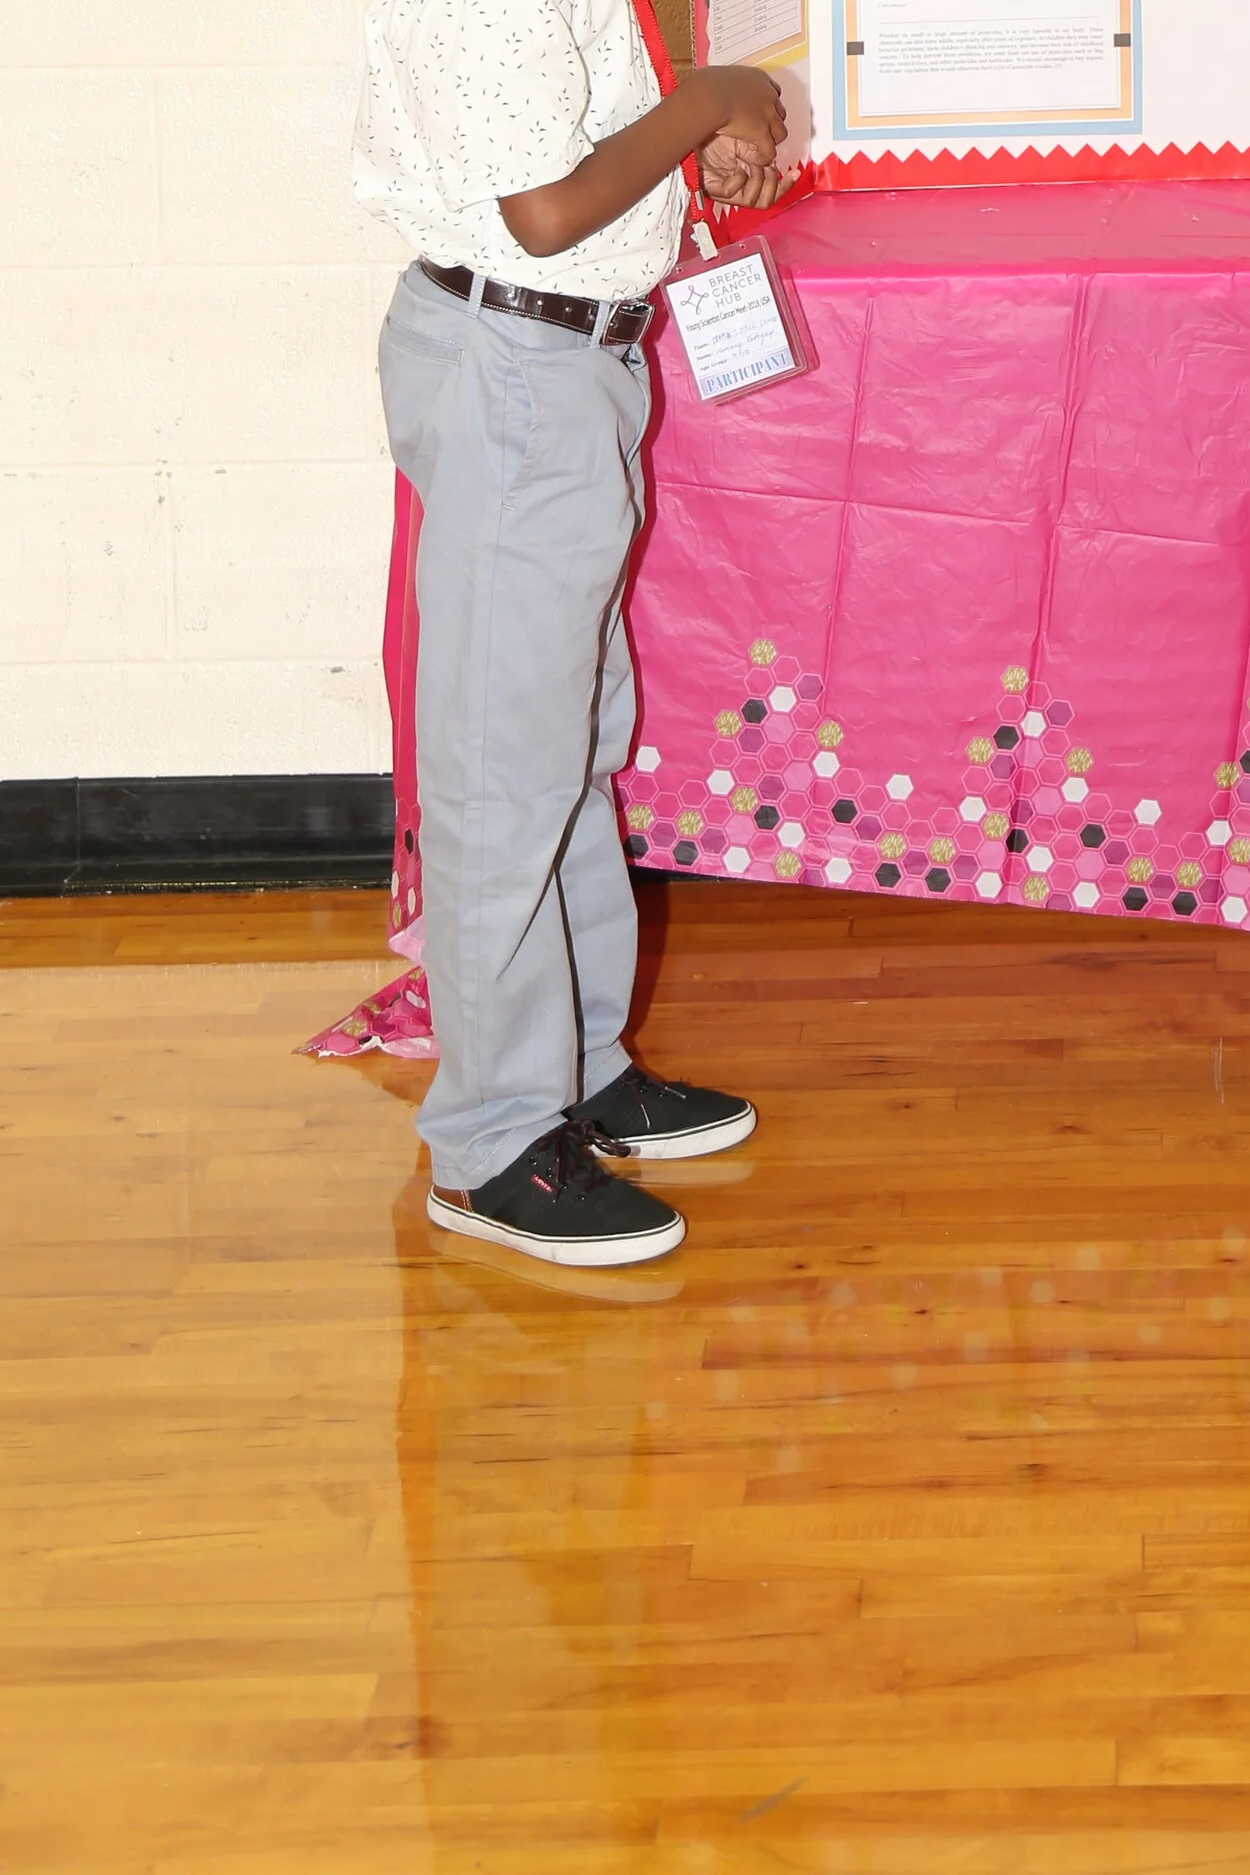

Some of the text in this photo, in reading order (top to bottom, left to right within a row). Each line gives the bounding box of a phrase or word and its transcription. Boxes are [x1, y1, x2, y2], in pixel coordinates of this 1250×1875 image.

[708, 263, 755, 287] BREAST
[712, 273, 763, 297] CANCER
[715, 292, 742, 308] HUB
[706, 353, 789, 393] PARTICIPANT
